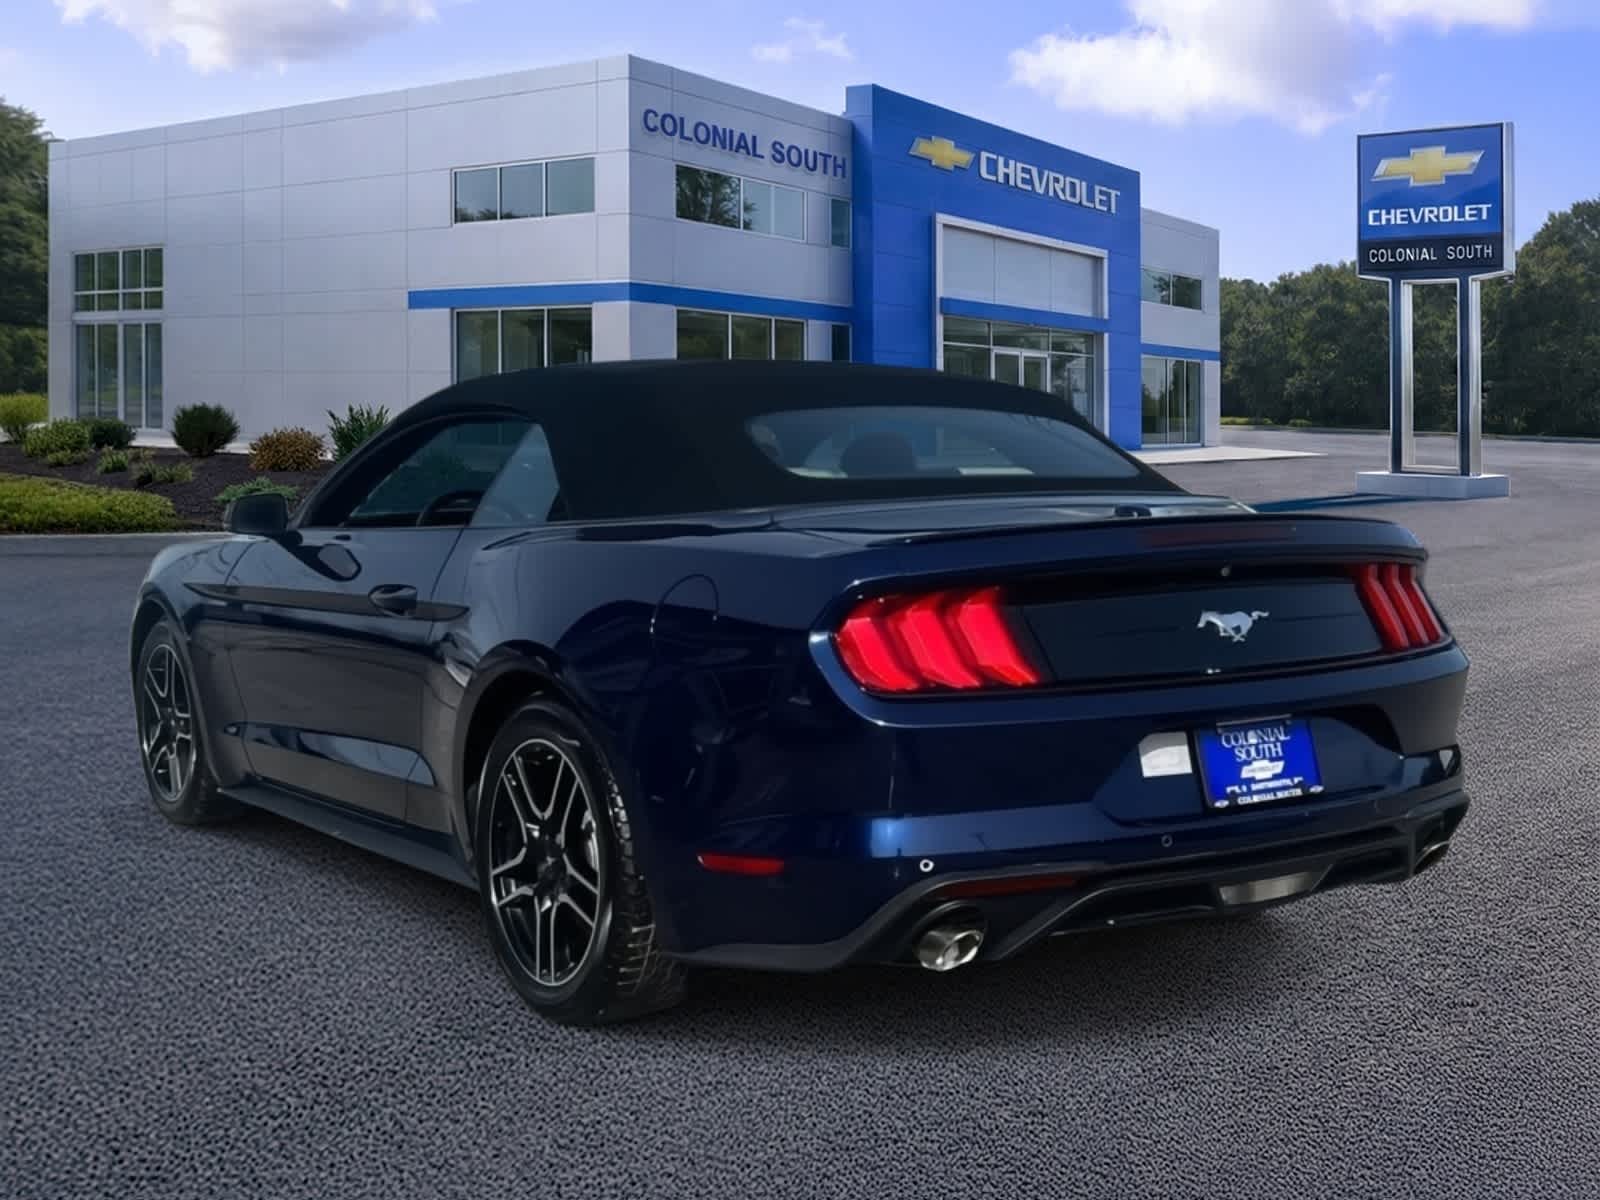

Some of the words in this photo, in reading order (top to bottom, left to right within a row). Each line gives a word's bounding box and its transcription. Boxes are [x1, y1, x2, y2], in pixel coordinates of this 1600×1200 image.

[643, 108, 765, 160] COLONIAL
[771, 140, 847, 179] SOUTH
[979, 150, 1120, 214] CHEVROLET
[1368, 204, 1492, 226] CHEVROLET
[1369, 248, 1437, 263] COLONIAL
[1447, 245, 1493, 260] SOUTH
[1222, 726, 1291, 748] COLONIAL
[1235, 743, 1283, 762] SOUTH
